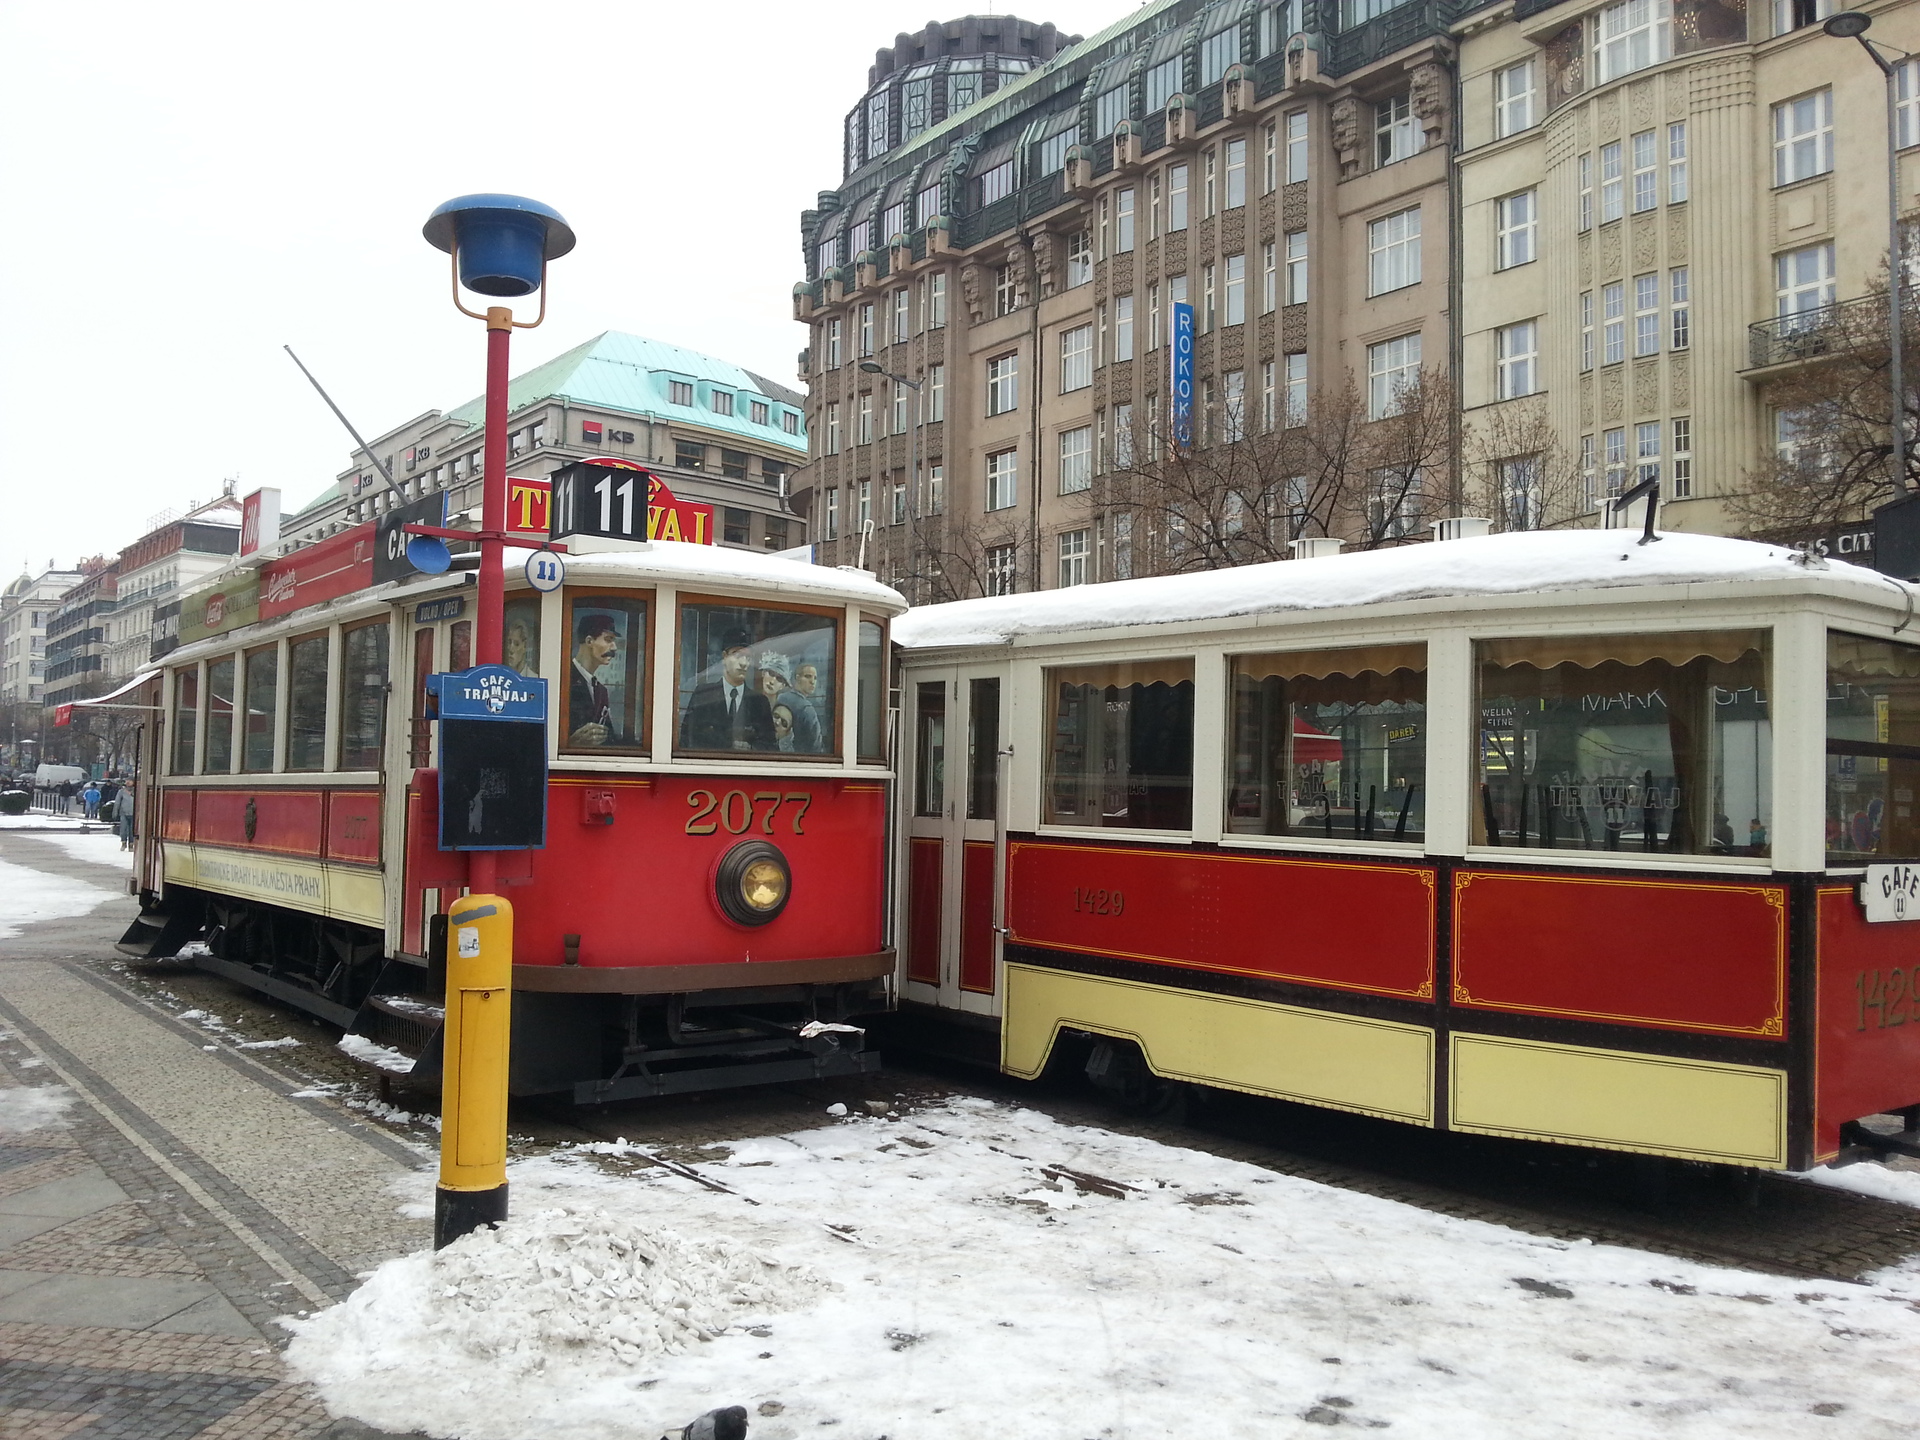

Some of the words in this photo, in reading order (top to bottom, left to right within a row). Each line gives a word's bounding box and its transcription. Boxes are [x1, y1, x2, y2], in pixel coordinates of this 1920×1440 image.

[1178, 312, 1190, 442] ROKOKO
[608, 429, 634, 444] KB
[417, 446, 430, 462] KB
[361, 474, 373, 488] KB
[557, 473, 574, 534] 11
[594, 475, 634, 534] 11
[243, 502, 260, 552] illy
[537, 561, 556, 581] 11
[443, 601, 459, 616] OPEN
[480, 675, 512, 689] CAFE
[463, 686, 528, 702] TRAMVAJ
[685, 789, 812, 835] 2077
[1882, 866, 1919, 898] CAFE
[1073, 887, 1125, 916] 1429
[1896, 898, 1904, 913] 11
